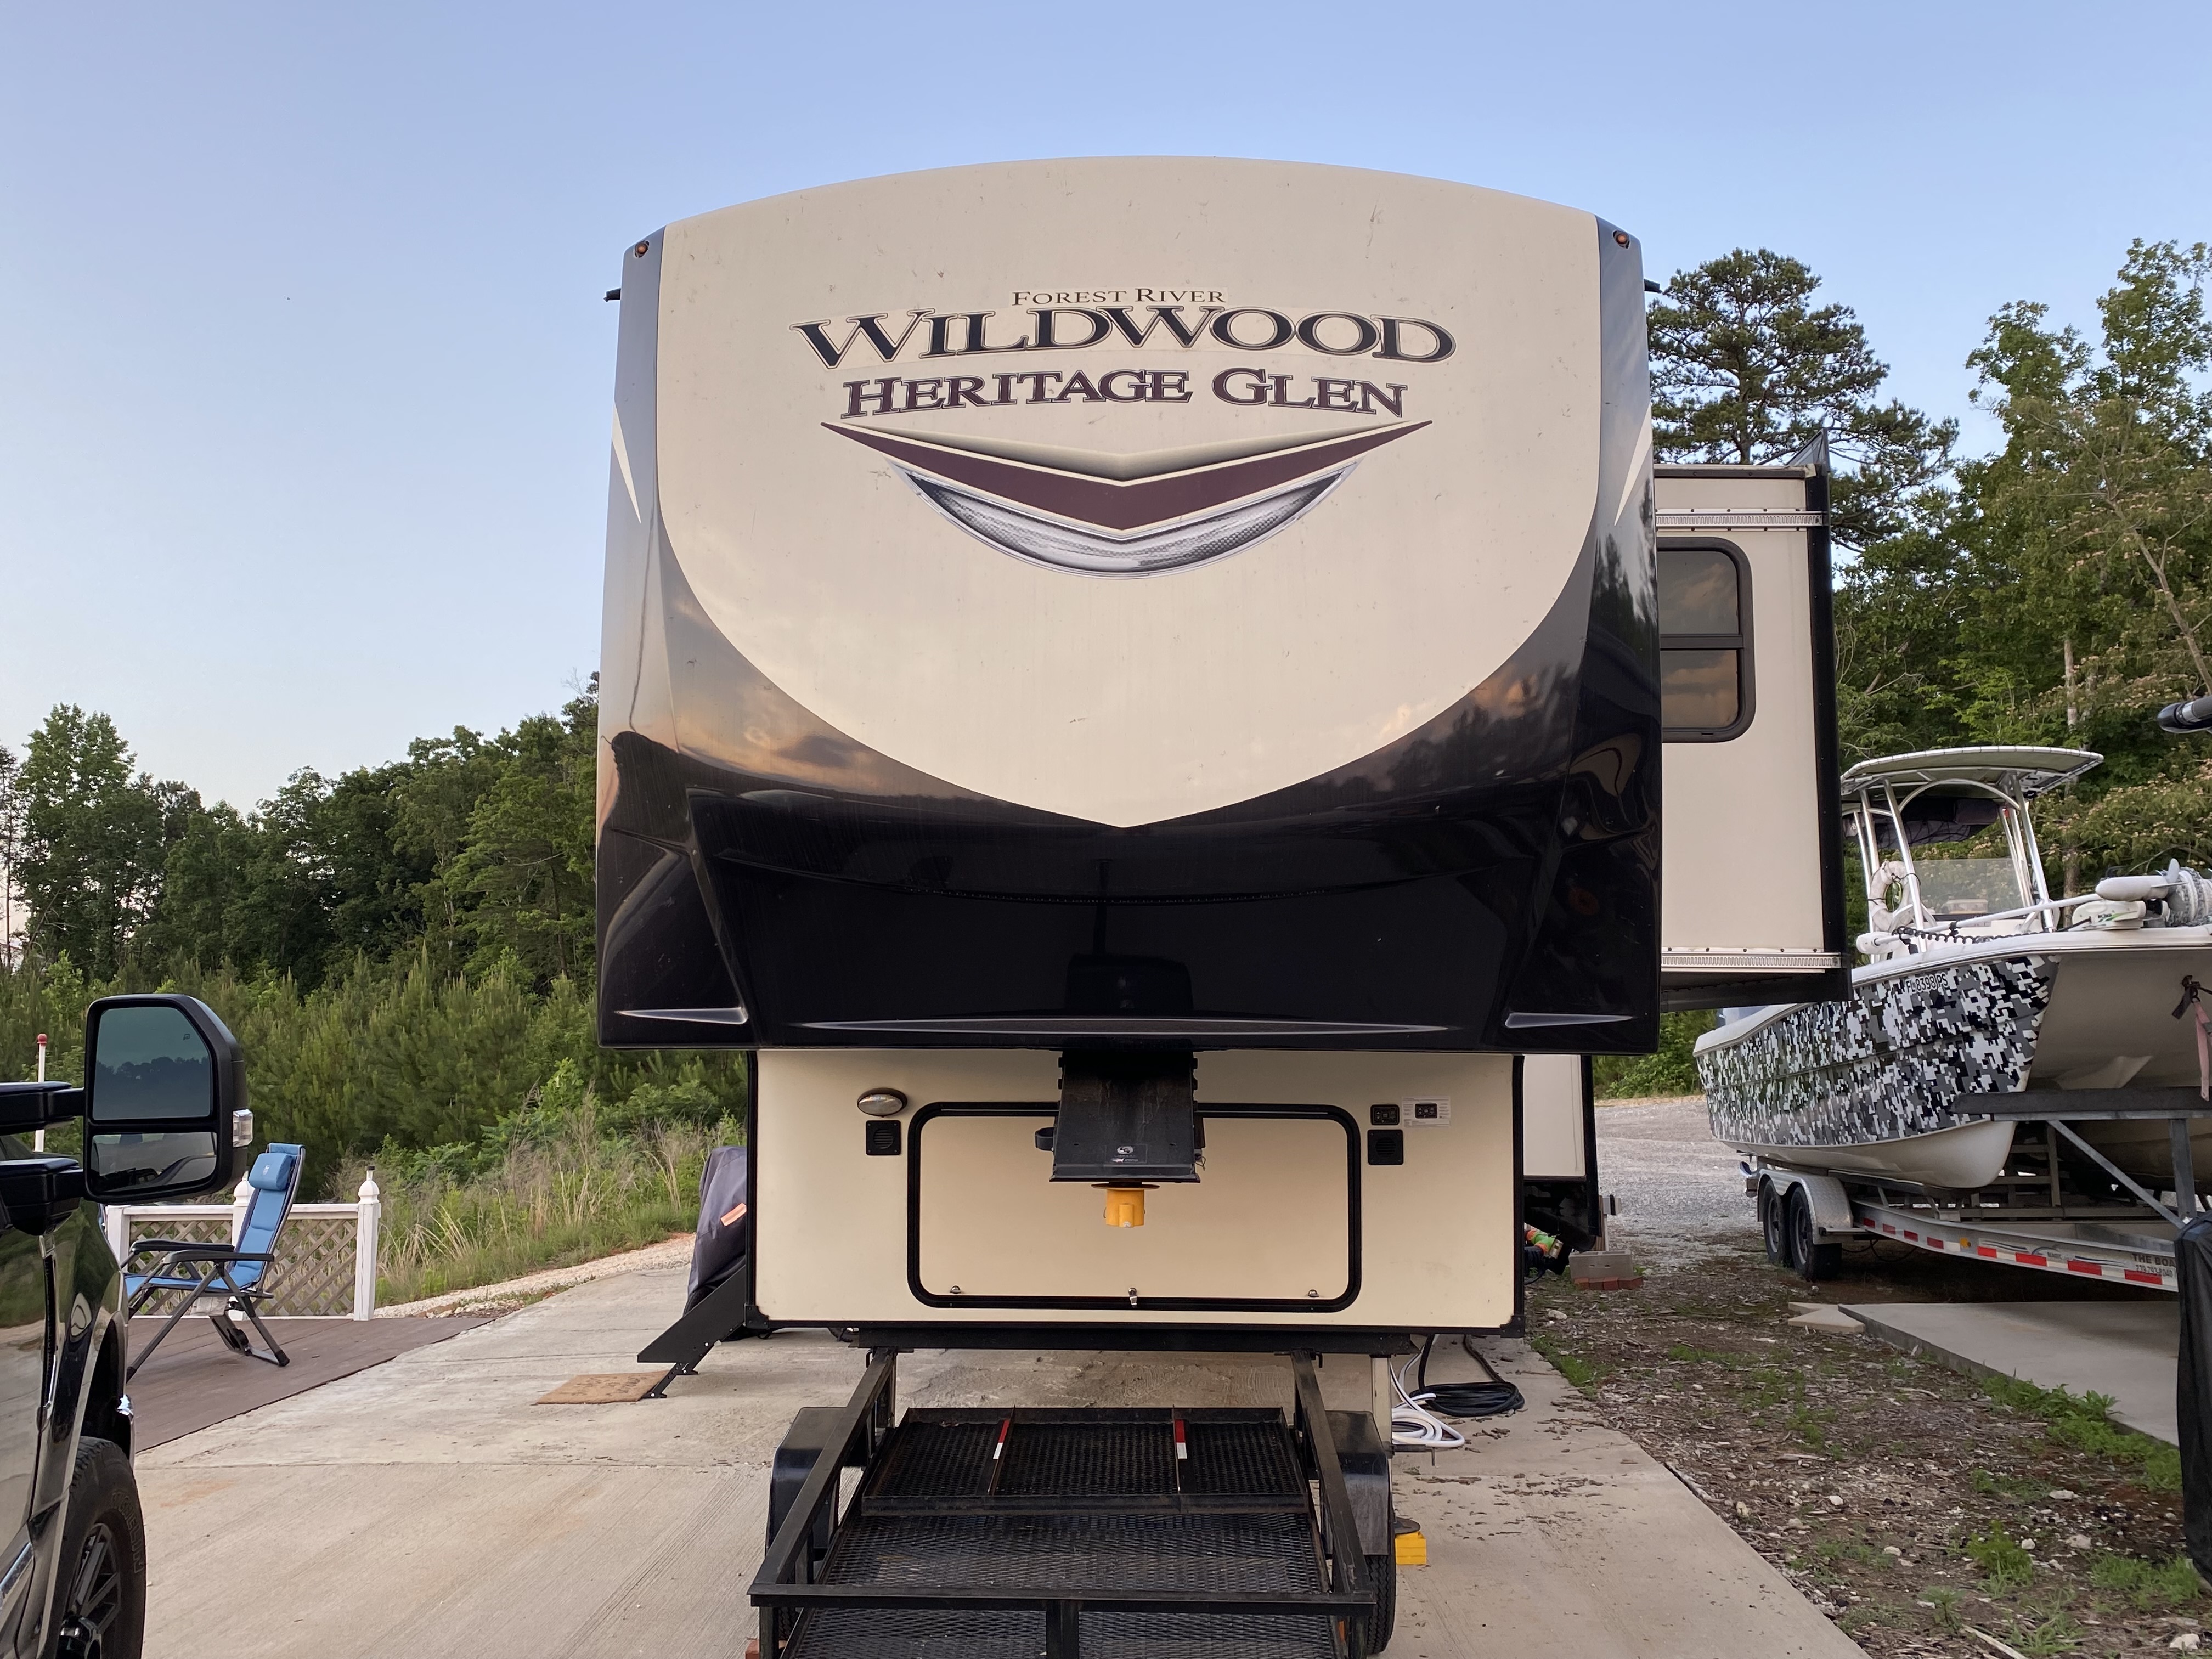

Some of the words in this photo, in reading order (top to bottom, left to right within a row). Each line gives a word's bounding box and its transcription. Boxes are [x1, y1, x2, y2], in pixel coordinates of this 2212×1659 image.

[1012, 291, 1127, 306] FOREST
[1134, 288, 1226, 303] RIVER
[789, 305, 1457, 369] WILDWOOD
[840, 369, 1193, 419] HERITAGE
[1211, 368, 1408, 418] GLEN
[1915, 975, 1937, 992] 8398
[1936, 973, 1949, 988] PS
[2132, 1253, 2152, 1264] THE
